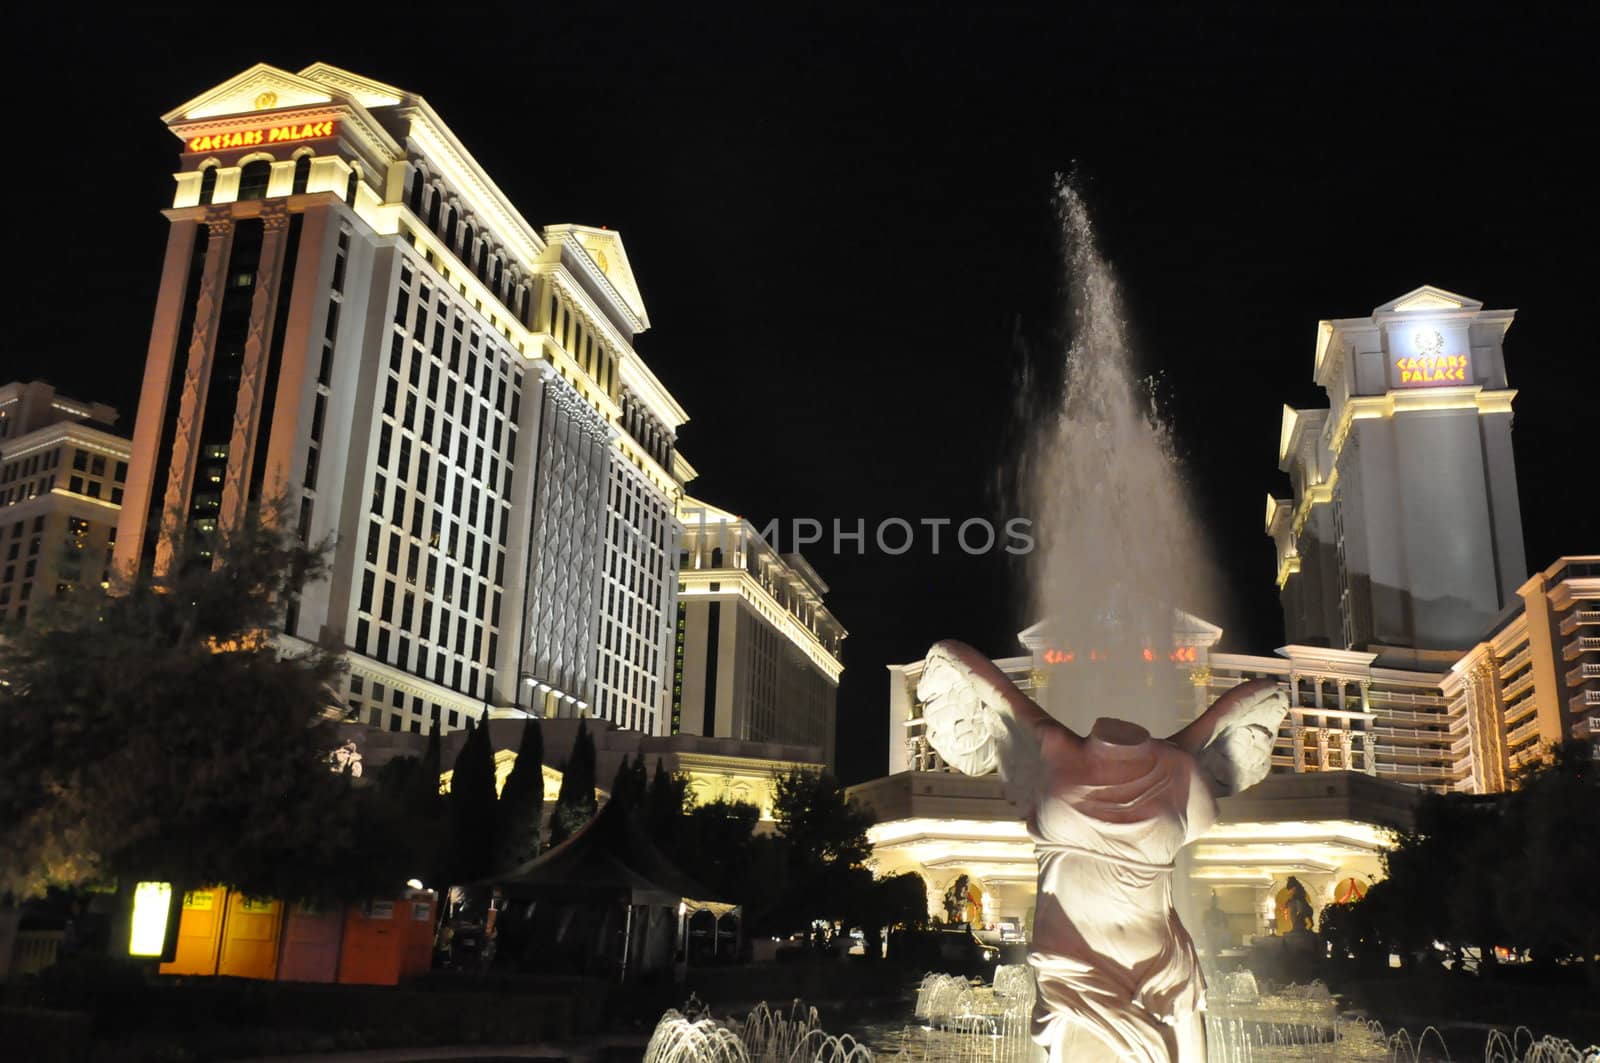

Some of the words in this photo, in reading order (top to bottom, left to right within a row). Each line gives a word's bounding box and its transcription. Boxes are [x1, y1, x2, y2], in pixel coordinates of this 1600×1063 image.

[189, 131, 264, 151] CAESARS
[268, 121, 333, 142] PALACE
[1396, 355, 1467, 369] CAESARS
[1401, 368, 1465, 382] PALACE
